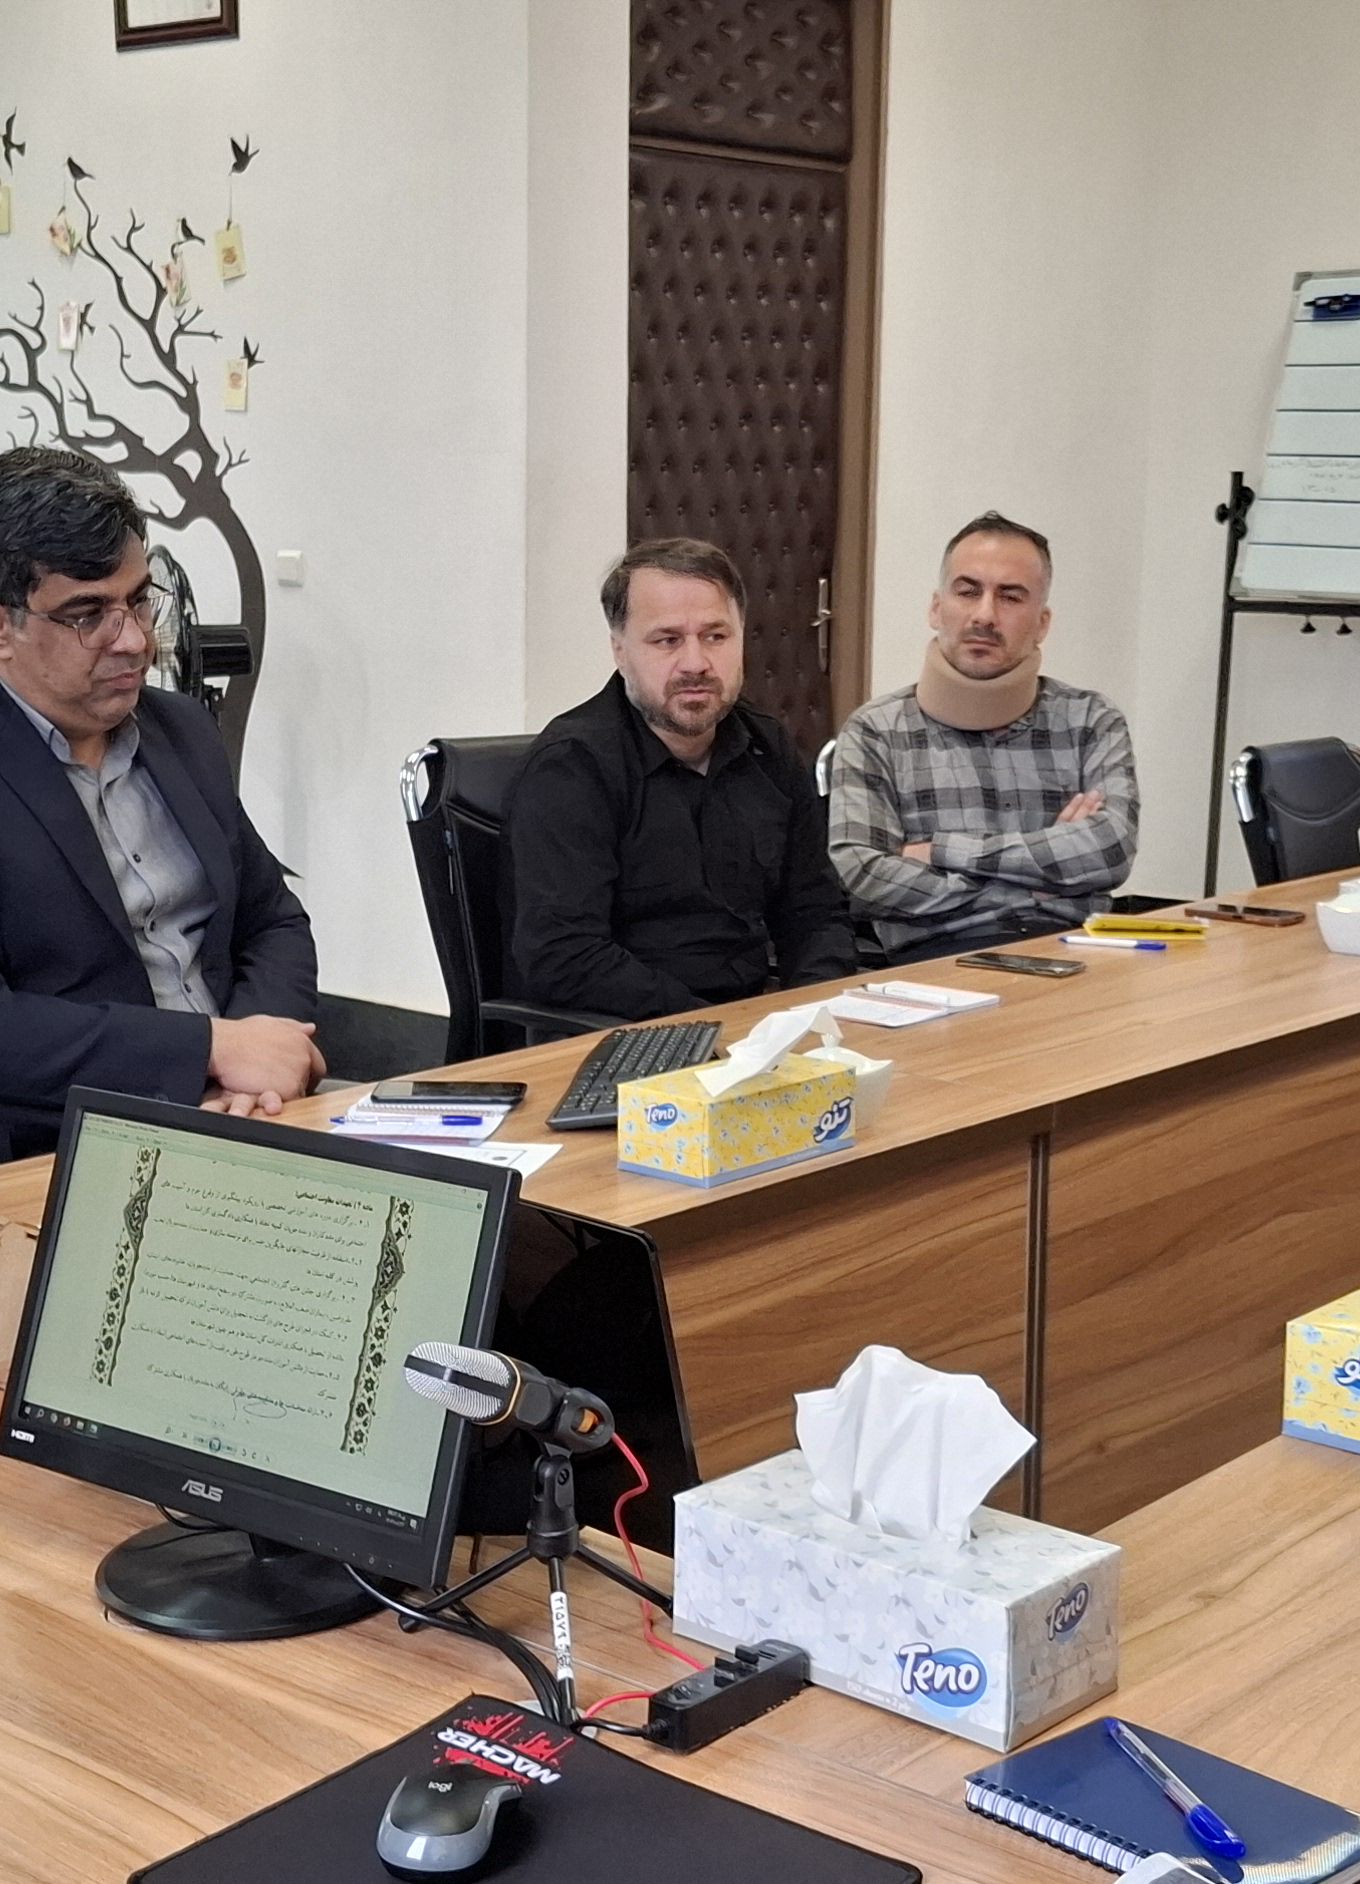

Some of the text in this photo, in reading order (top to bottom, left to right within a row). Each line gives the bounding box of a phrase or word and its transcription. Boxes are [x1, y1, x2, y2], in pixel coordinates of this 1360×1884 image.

[643, 1102, 677, 1127] Teno
[813, 1097, 854, 1142] تنو
[181, 1479, 224, 1503] ASUS
[1046, 1587, 1087, 1641] Teno
[897, 1641, 981, 1695] Teno
[436, 1726, 562, 1785] MACHER
[427, 1780, 454, 1793] logi
